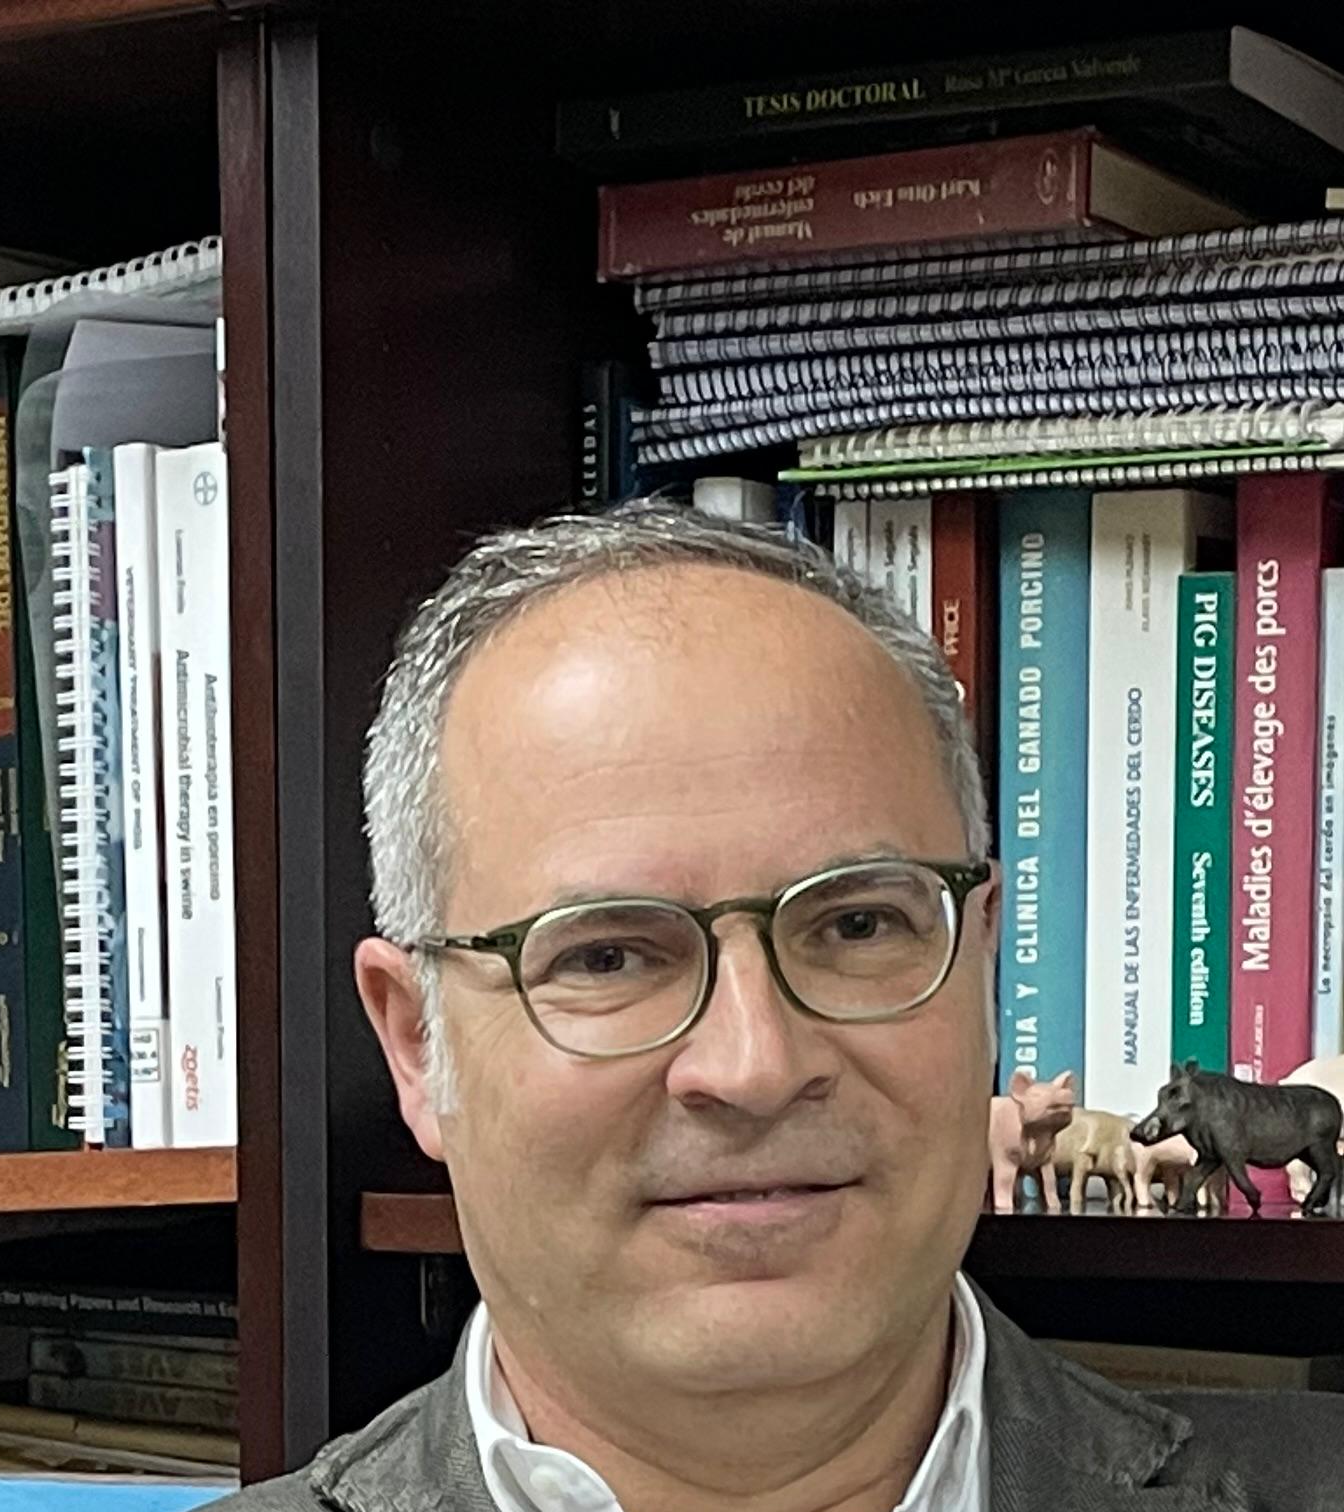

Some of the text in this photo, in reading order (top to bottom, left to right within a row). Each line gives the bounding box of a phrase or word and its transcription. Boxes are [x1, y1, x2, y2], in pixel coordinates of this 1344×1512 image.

[742, 76, 927, 121] TESIS DOCTORAL
[721, 221, 814, 247] Manual de
[942, 598, 961, 657] PRICE
[175, 649, 195, 921] Antimicrobial therapy in swine
[203, 673, 223, 902] Antibioterapia en porcino
[1014, 532, 1044, 999] Y CLINICA DEL GANADO PORCINO
[1123, 687, 1143, 1067] MANUAL DE LAS ENFERMEDADES DEL CERDO
[1187, 591, 1219, 1027] PIG DISEASES Seventh edition
[1240, 559, 1286, 973] Maladies d'élevage des porcs
[1317, 795, 1338, 997] La necropsia del cerdo en
[181, 1043, 201, 1113] zoetis
